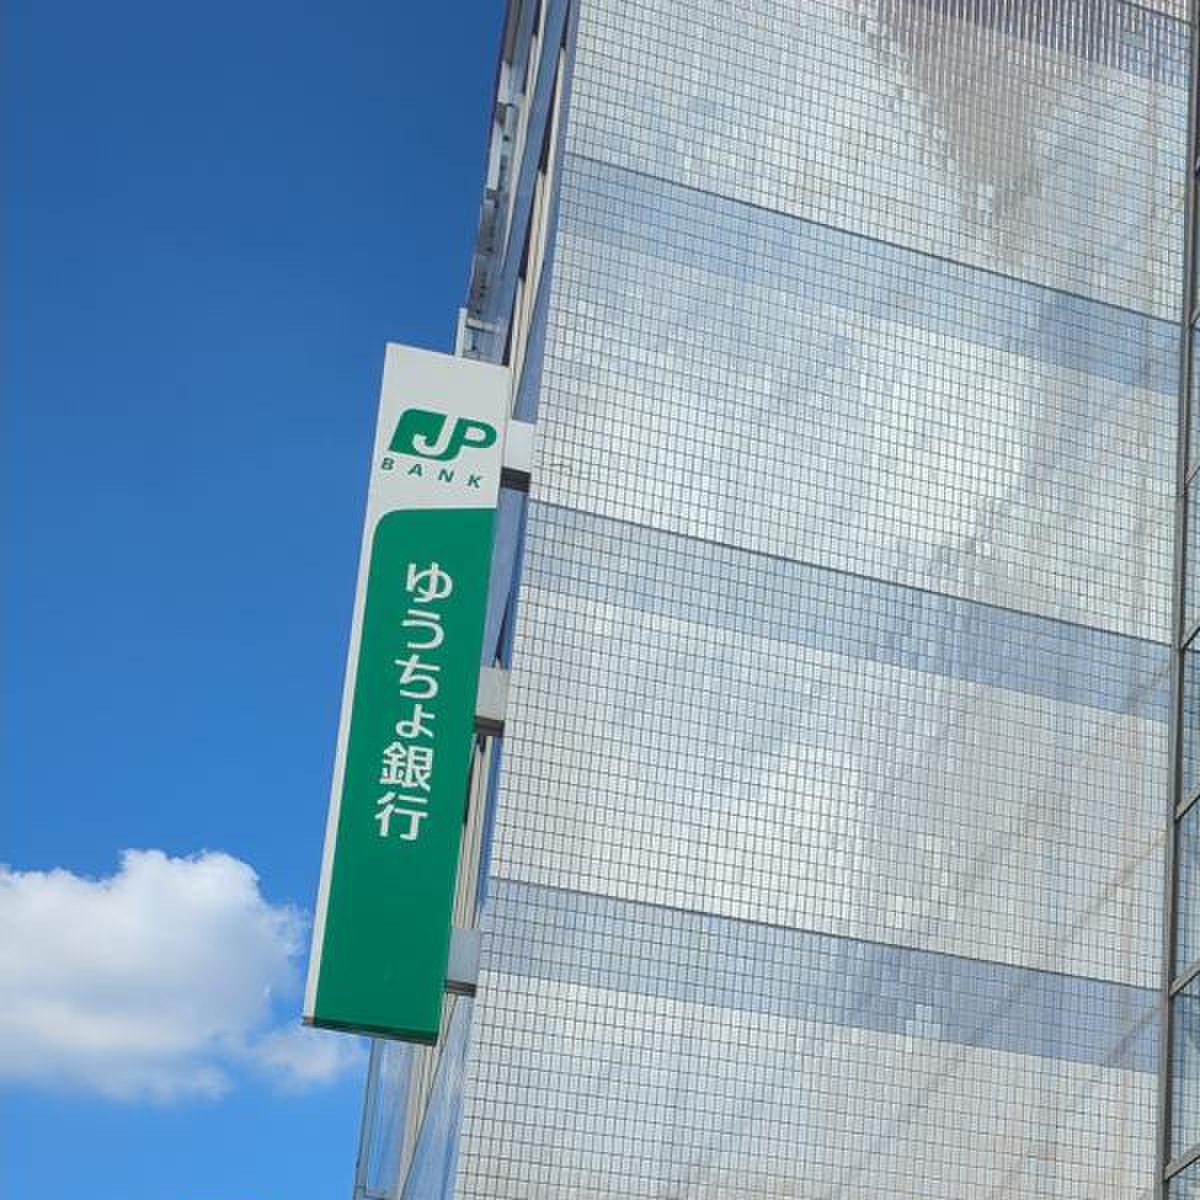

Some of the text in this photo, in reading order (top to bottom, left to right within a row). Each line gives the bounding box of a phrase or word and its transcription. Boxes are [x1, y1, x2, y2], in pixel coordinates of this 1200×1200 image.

[388, 408, 497, 461] JP
[381, 457, 483, 488] BANK
[375, 561, 453, 841] ゆうちょ銀行
